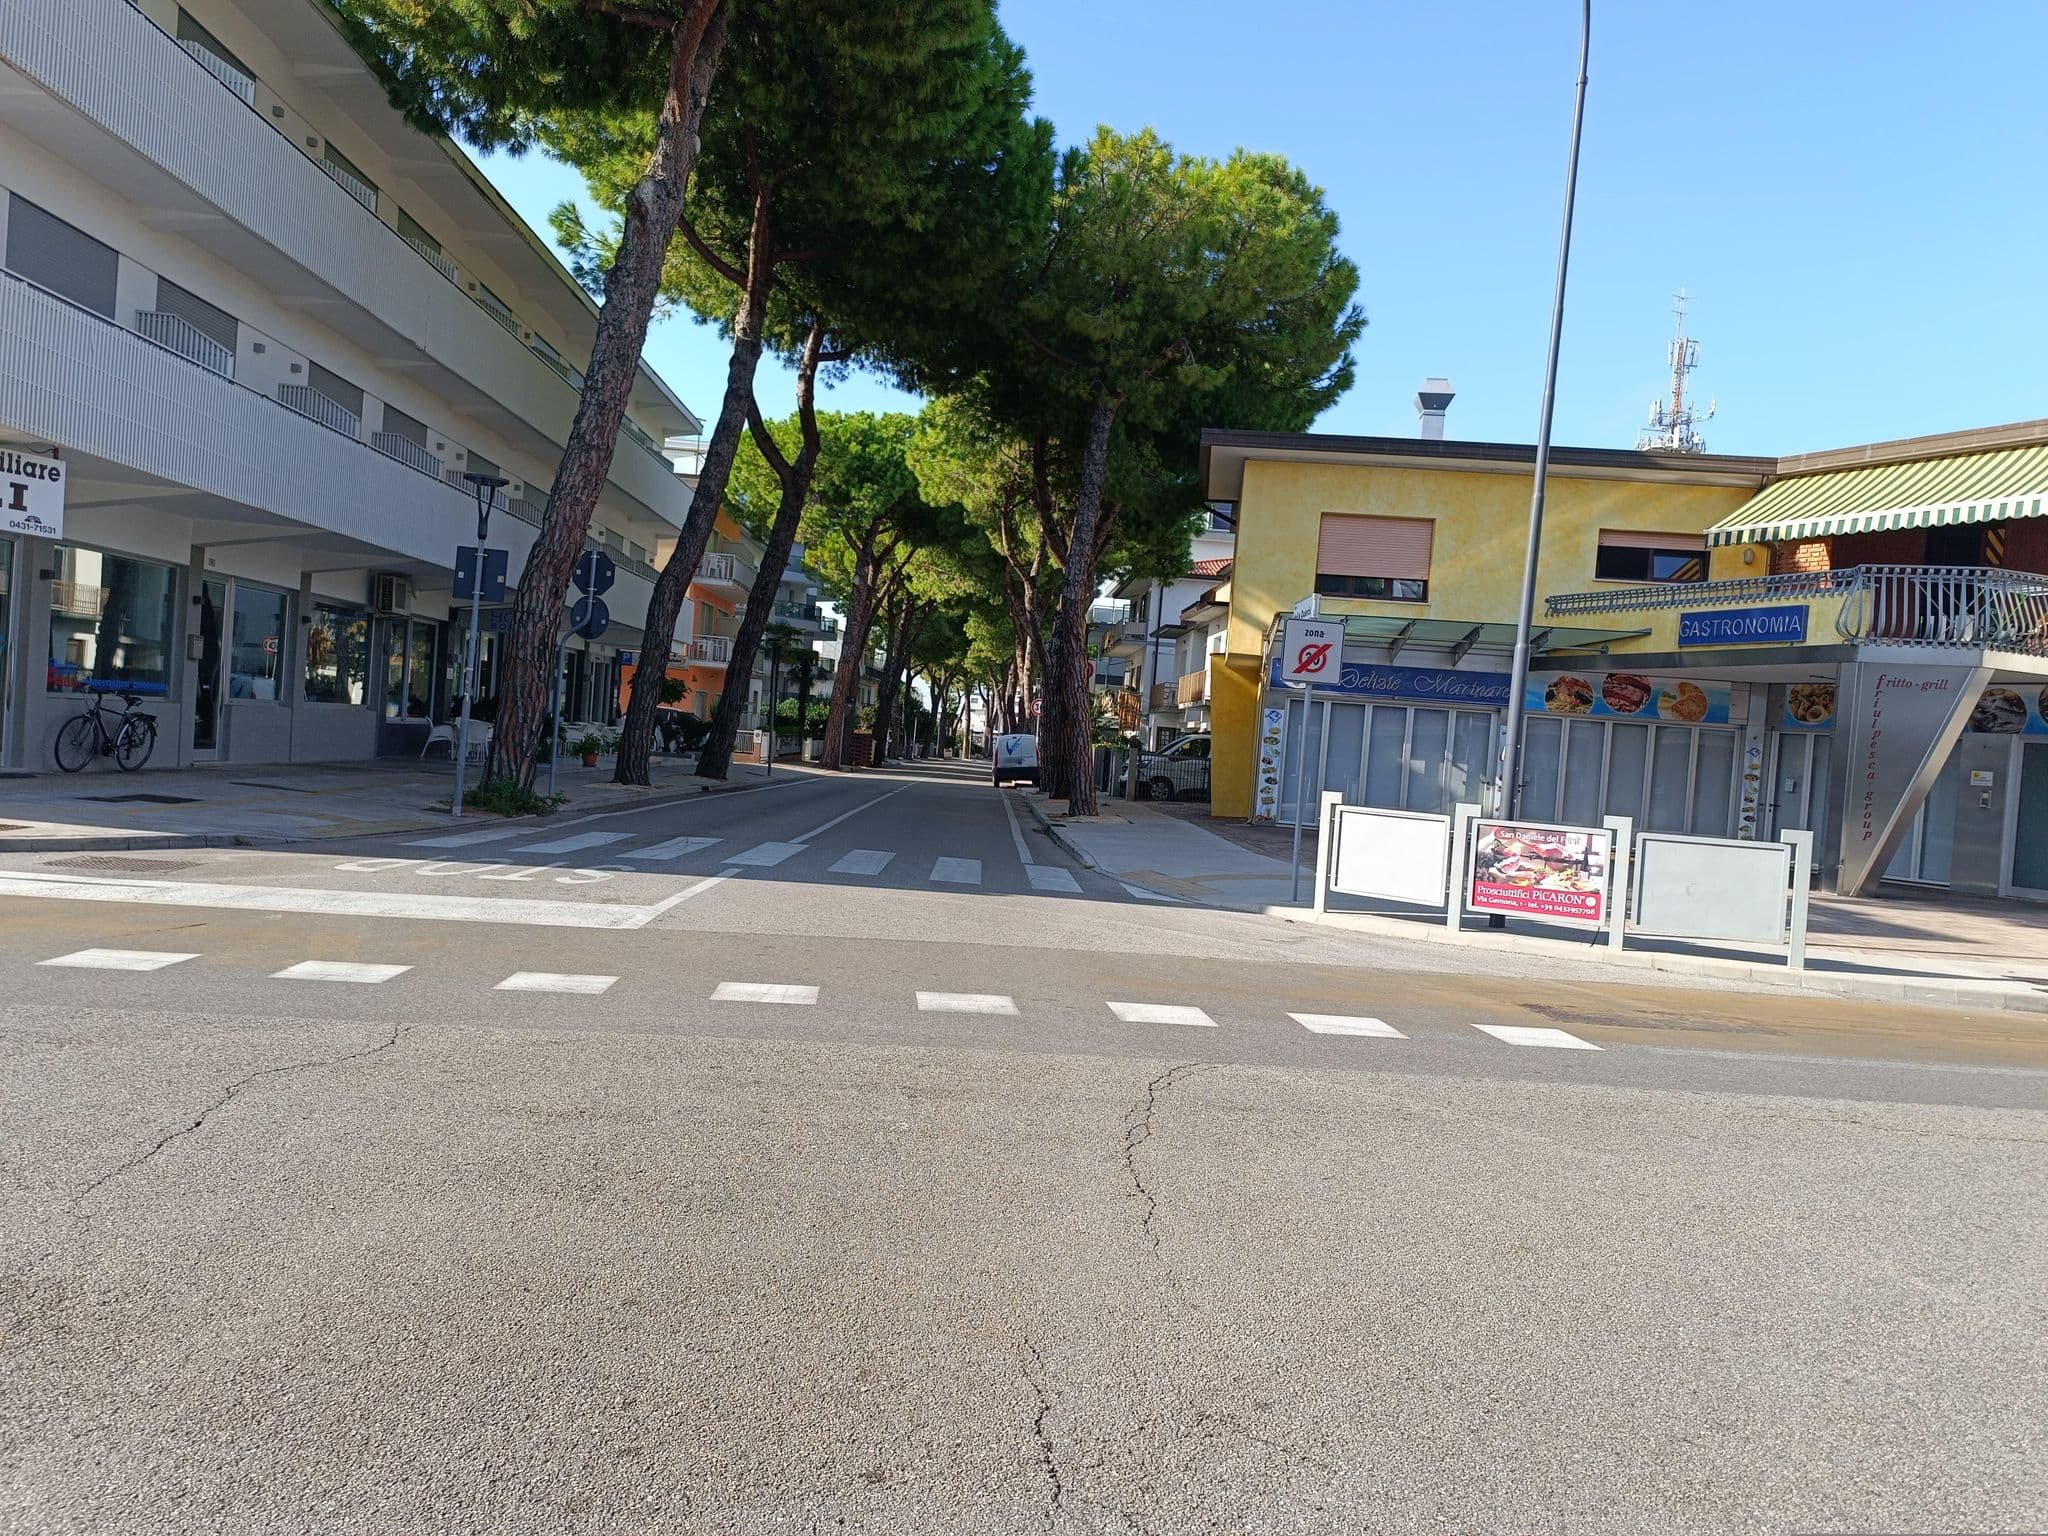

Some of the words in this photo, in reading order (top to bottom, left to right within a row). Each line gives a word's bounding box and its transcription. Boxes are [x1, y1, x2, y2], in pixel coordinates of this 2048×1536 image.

[9, 520, 57, 535] 0431-71531
[1679, 615, 1801, 637] GASTRONOMIA
[1305, 629, 1325, 638] zona
[1340, 668, 1402, 691] Delizie
[1875, 673, 1913, 690] fritto
[1921, 679, 1949, 692] grill
[1500, 830, 1515, 839] San
[1516, 831, 1545, 842] Daniele
[1546, 834, 1560, 843] del
[1478, 885, 1530, 899] Prosciuttifici
[1488, 897, 1519, 908] Gemona,
[1528, 901, 1539, 909] tel.
